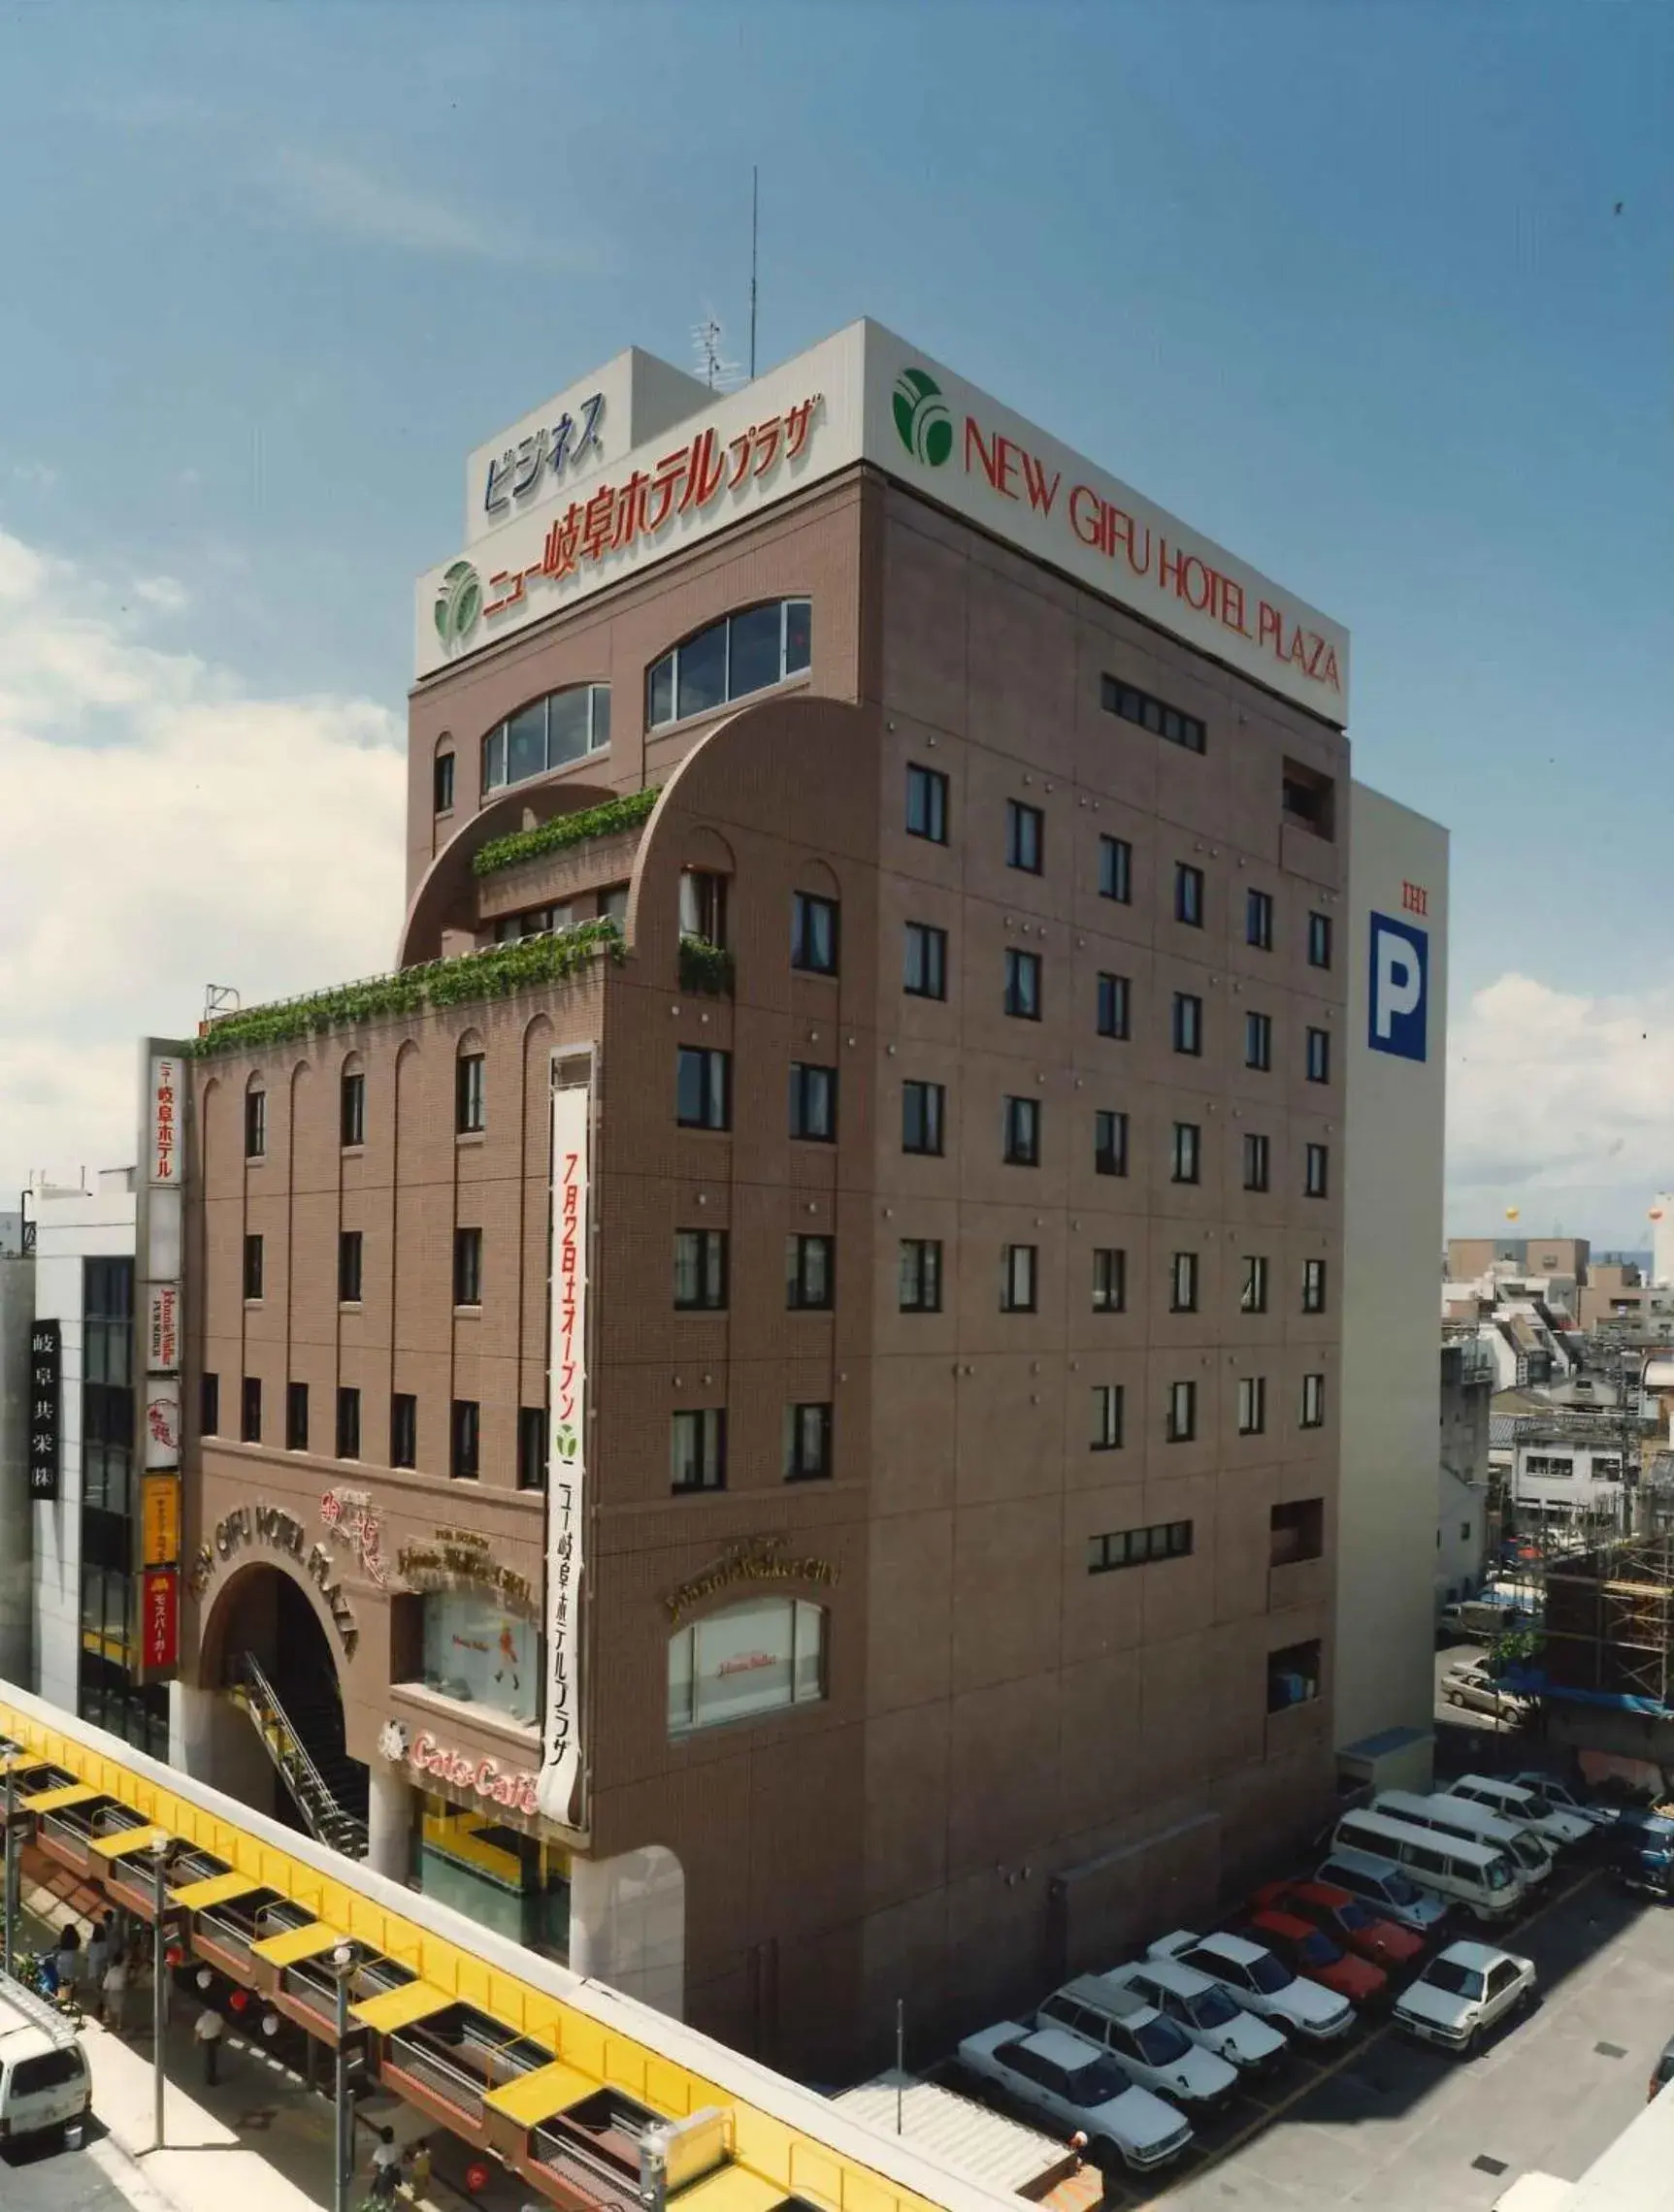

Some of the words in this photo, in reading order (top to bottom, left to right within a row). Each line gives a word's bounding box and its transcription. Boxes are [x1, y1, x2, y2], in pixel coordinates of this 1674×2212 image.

[483, 393, 825, 618] ニュー岐阜ホテルプラザ
[485, 392, 607, 514] ビジネス
[965, 415, 1062, 520] NEW
[1069, 485, 1151, 575] GIFU
[1159, 537, 1253, 640] HOTEL
[1258, 601, 1341, 693] PLAZA
[1401, 879, 1428, 917] IHI
[1376, 927, 1422, 1040] P
[156, 1061, 174, 1178] ニュー岐阜ホテル
